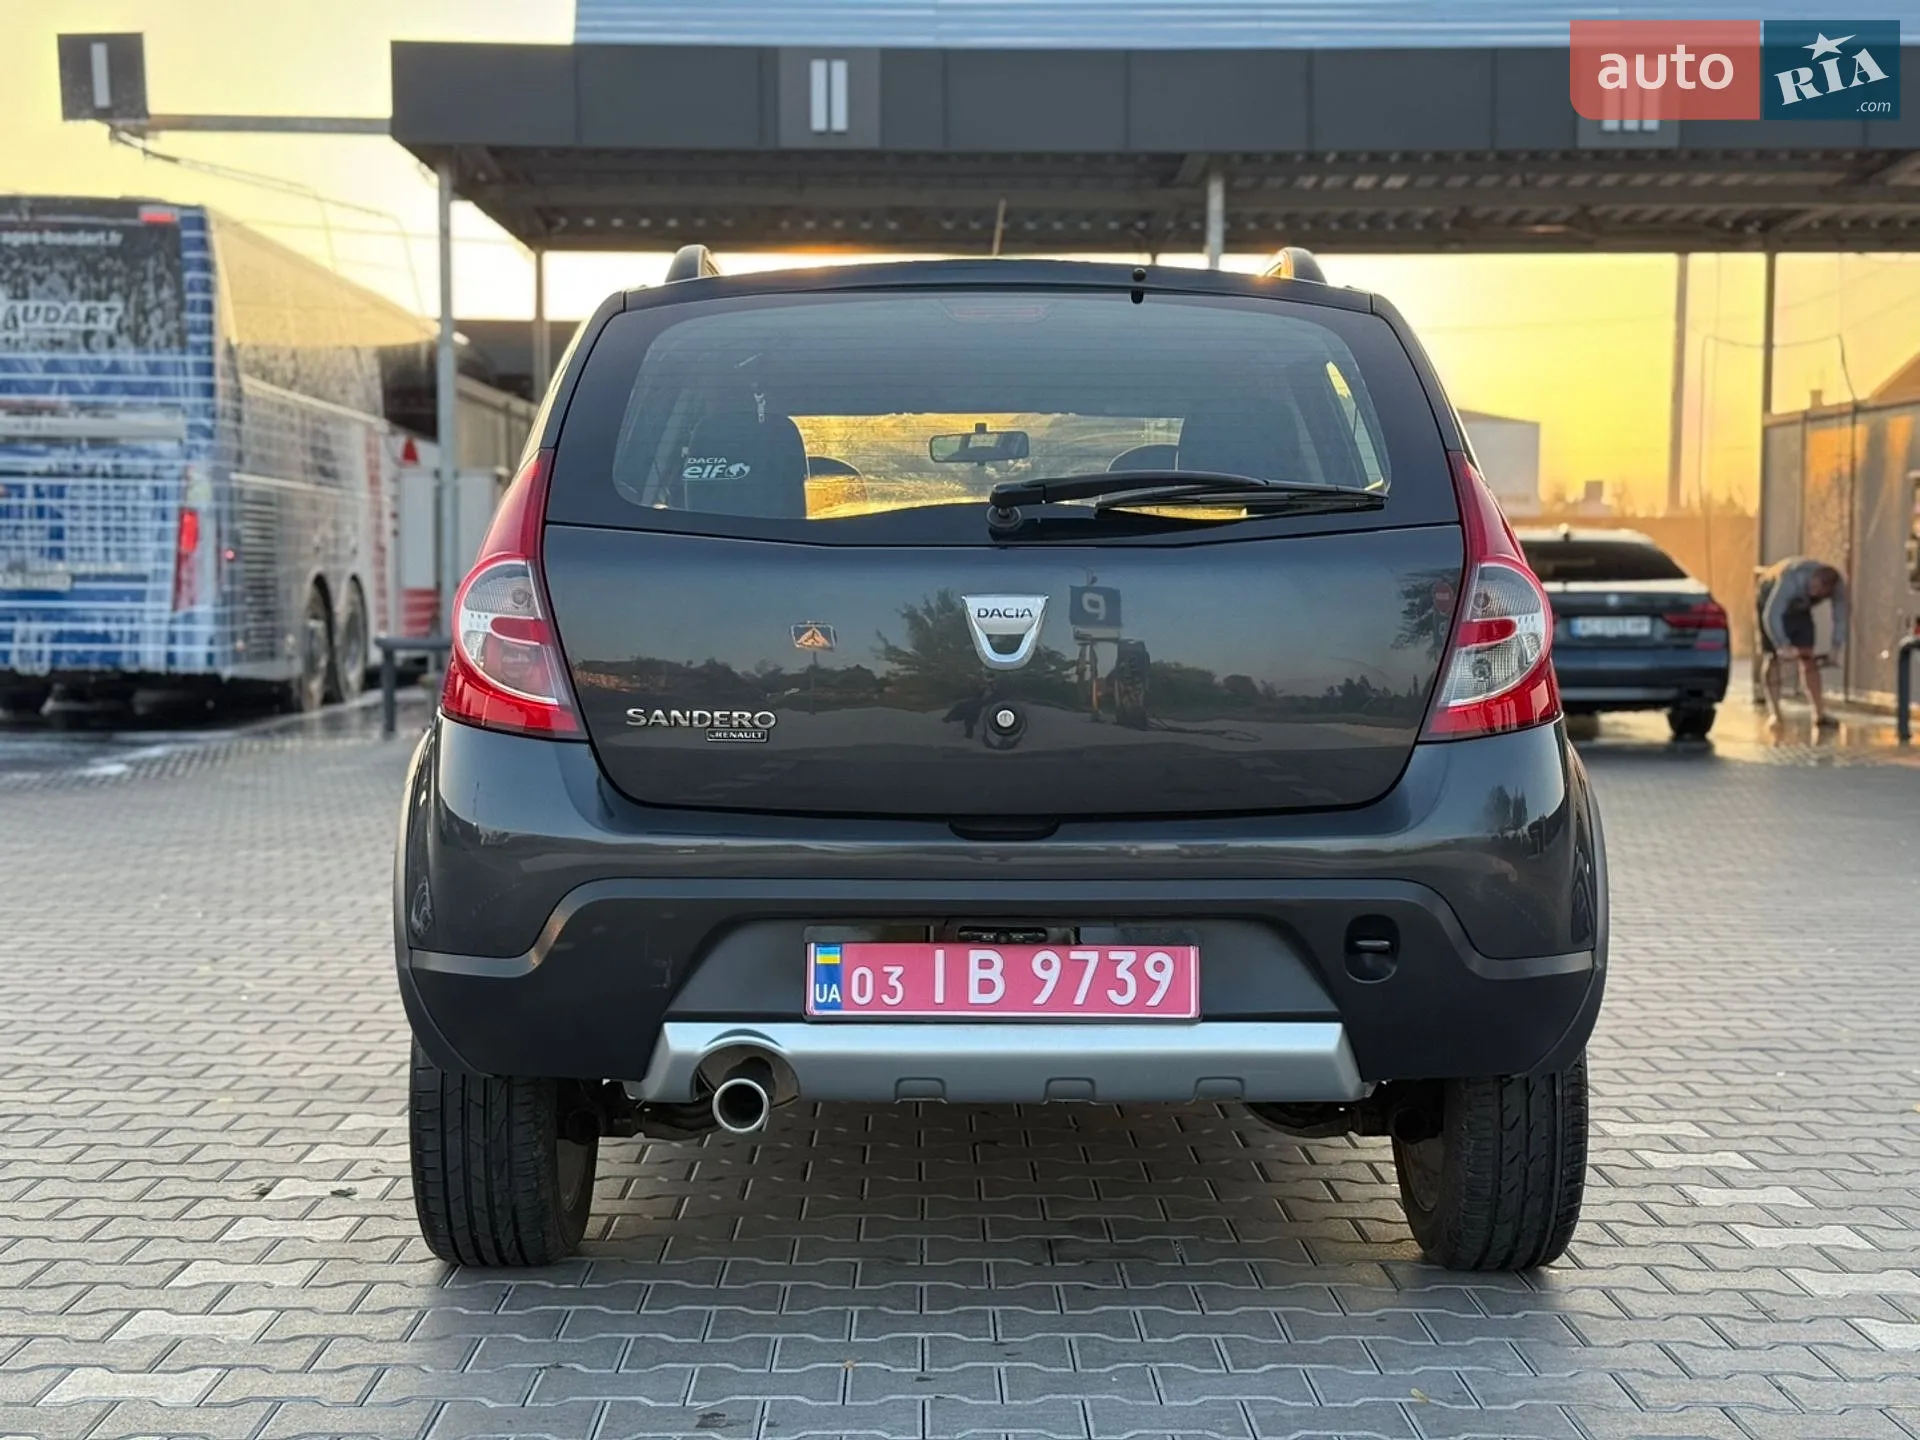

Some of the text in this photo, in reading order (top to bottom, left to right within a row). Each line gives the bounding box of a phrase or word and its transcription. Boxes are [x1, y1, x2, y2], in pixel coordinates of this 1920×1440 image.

[687, 456, 727, 464] DACIA
[682, 464, 727, 479] elf
[977, 607, 1033, 619] DACIA
[626, 707, 776, 729] SANDERO
[715, 731, 762, 739] RENAULT
[851, 966, 905, 1006] 03
[1031, 950, 1176, 1008] 9739
[815, 983, 841, 1003] UA
